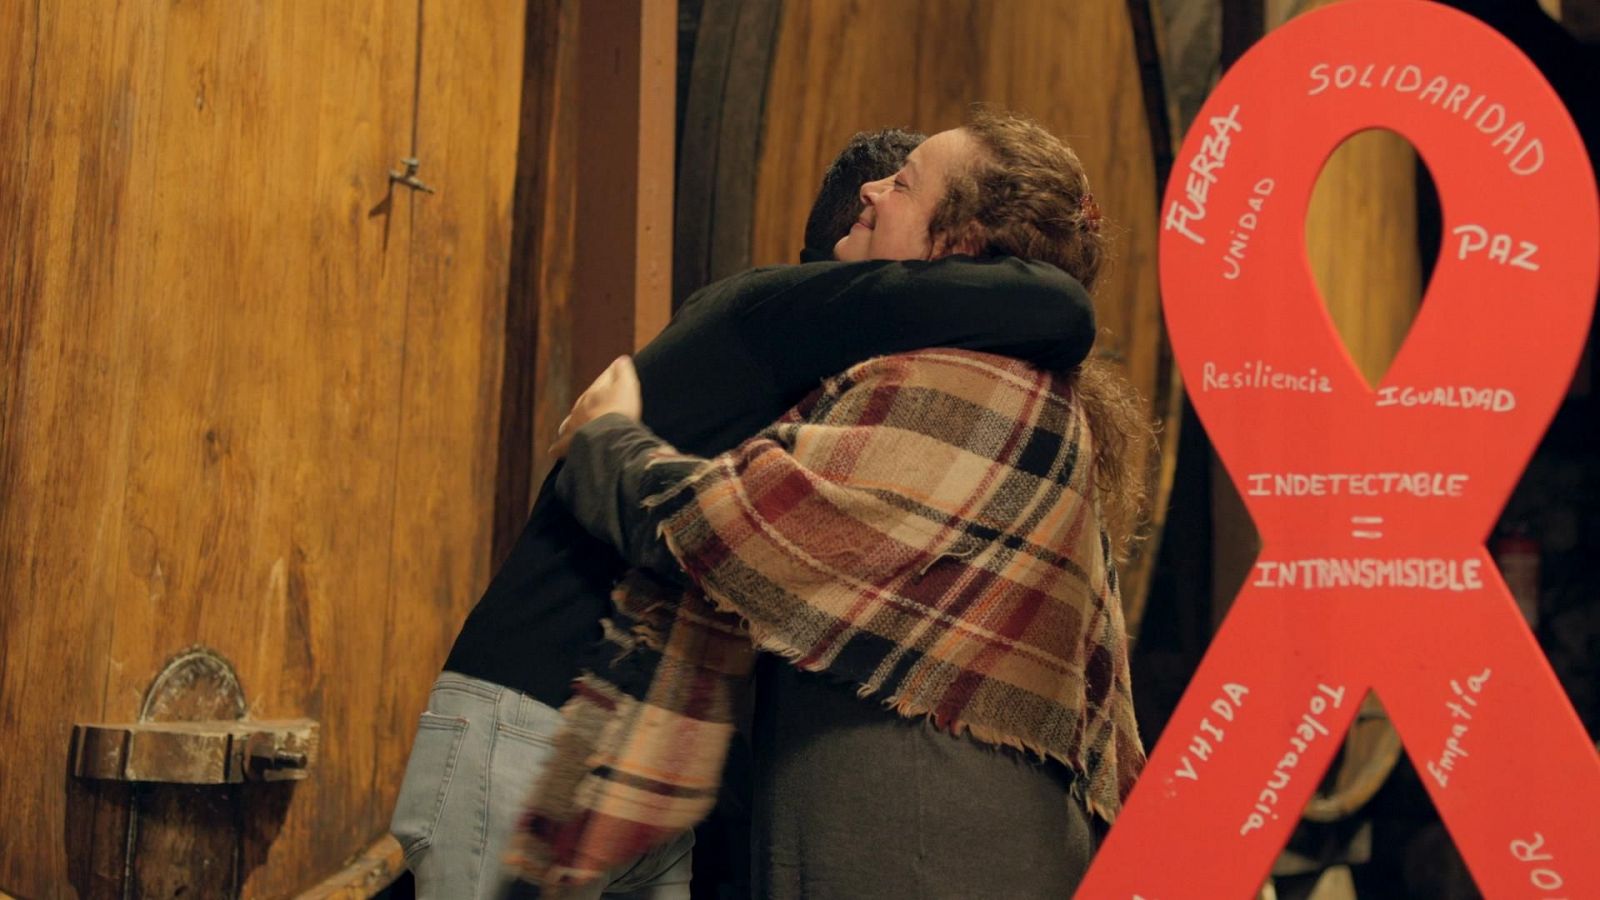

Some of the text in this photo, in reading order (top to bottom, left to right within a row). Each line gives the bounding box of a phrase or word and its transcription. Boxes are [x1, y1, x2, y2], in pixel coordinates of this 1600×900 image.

[1307, 63, 1545, 176] SOLIDARIDAD
[1165, 104, 1242, 245] FUERZA
[1223, 177, 1275, 280] UNIDAD
[1453, 224, 1539, 271] PAZ
[1203, 361, 1333, 393] Resiliencia
[1376, 386, 1516, 412] IGUALDAD
[1248, 472, 1469, 497] INDETECTABLE
[1254, 558, 1483, 592] INTRANSMISIBLE
[1174, 683, 1249, 781] VHIDA
[1239, 683, 1345, 837] Tolerancia
[1427, 668, 1491, 788] Empatía
[1510, 832, 1568, 900] OR
